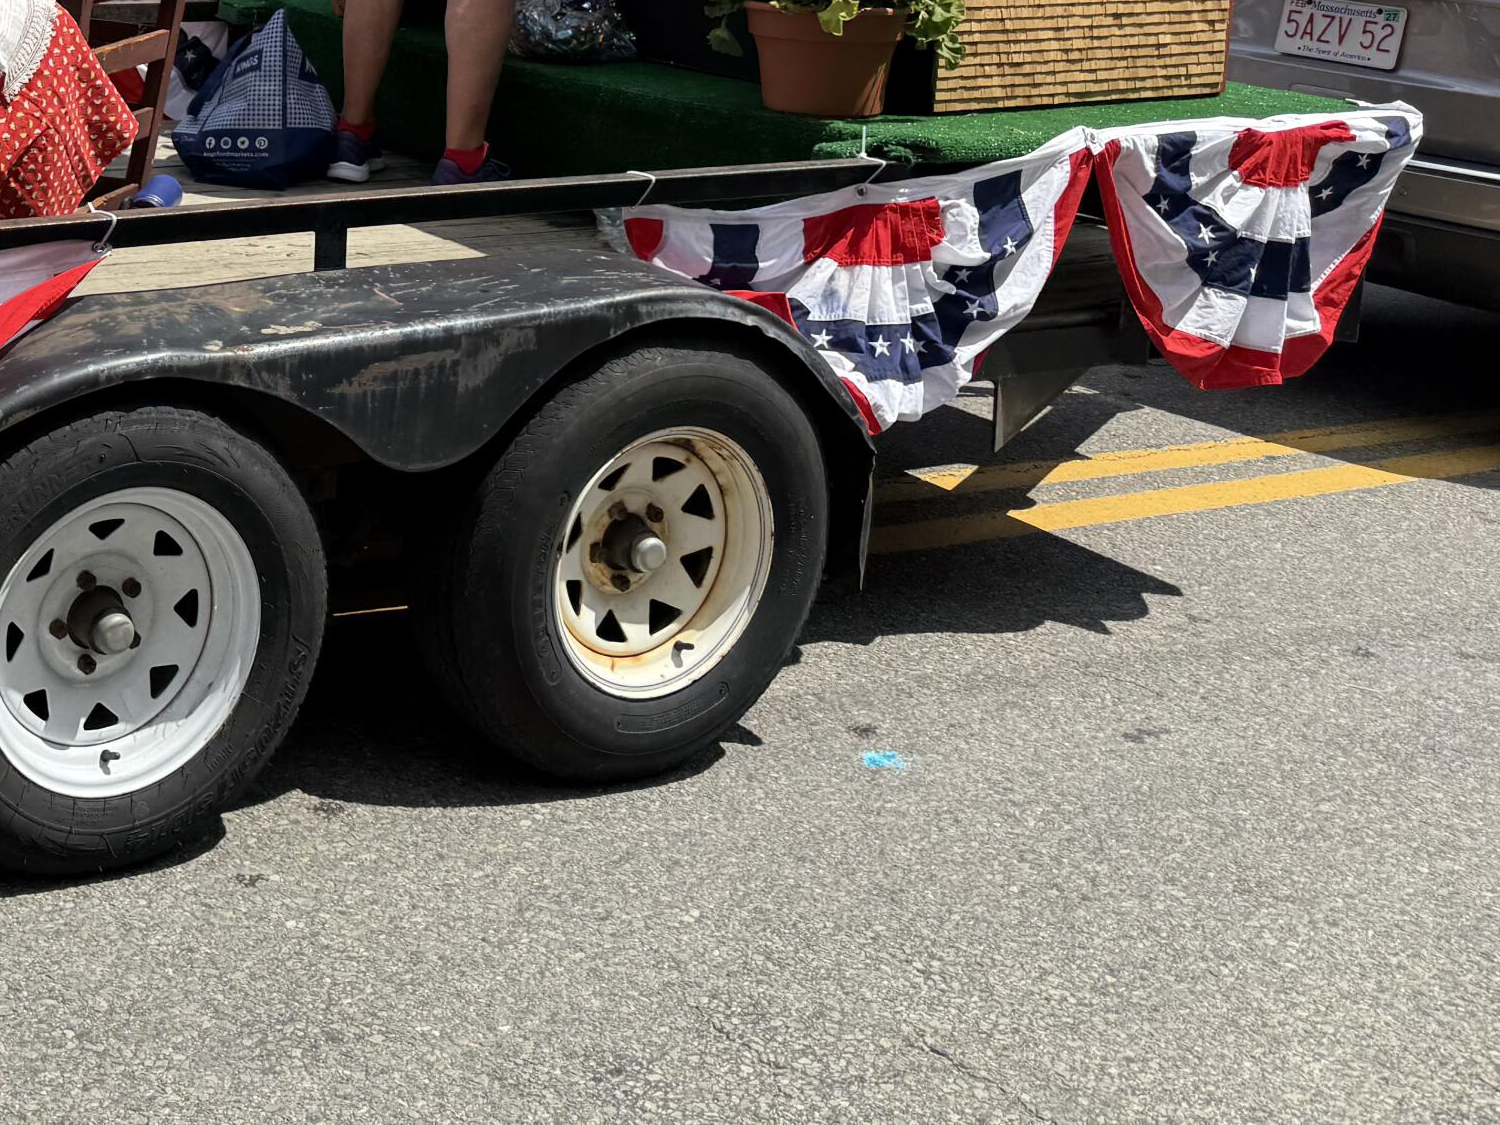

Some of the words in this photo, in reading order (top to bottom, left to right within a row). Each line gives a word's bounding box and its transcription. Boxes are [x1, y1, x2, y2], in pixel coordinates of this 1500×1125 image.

[1310, 0, 1378, 19] Massachusetts
[1385, 13, 1398, 21] 27
[1284, 9, 1352, 46] 5AZV
[1359, 20, 1395, 53] 52
